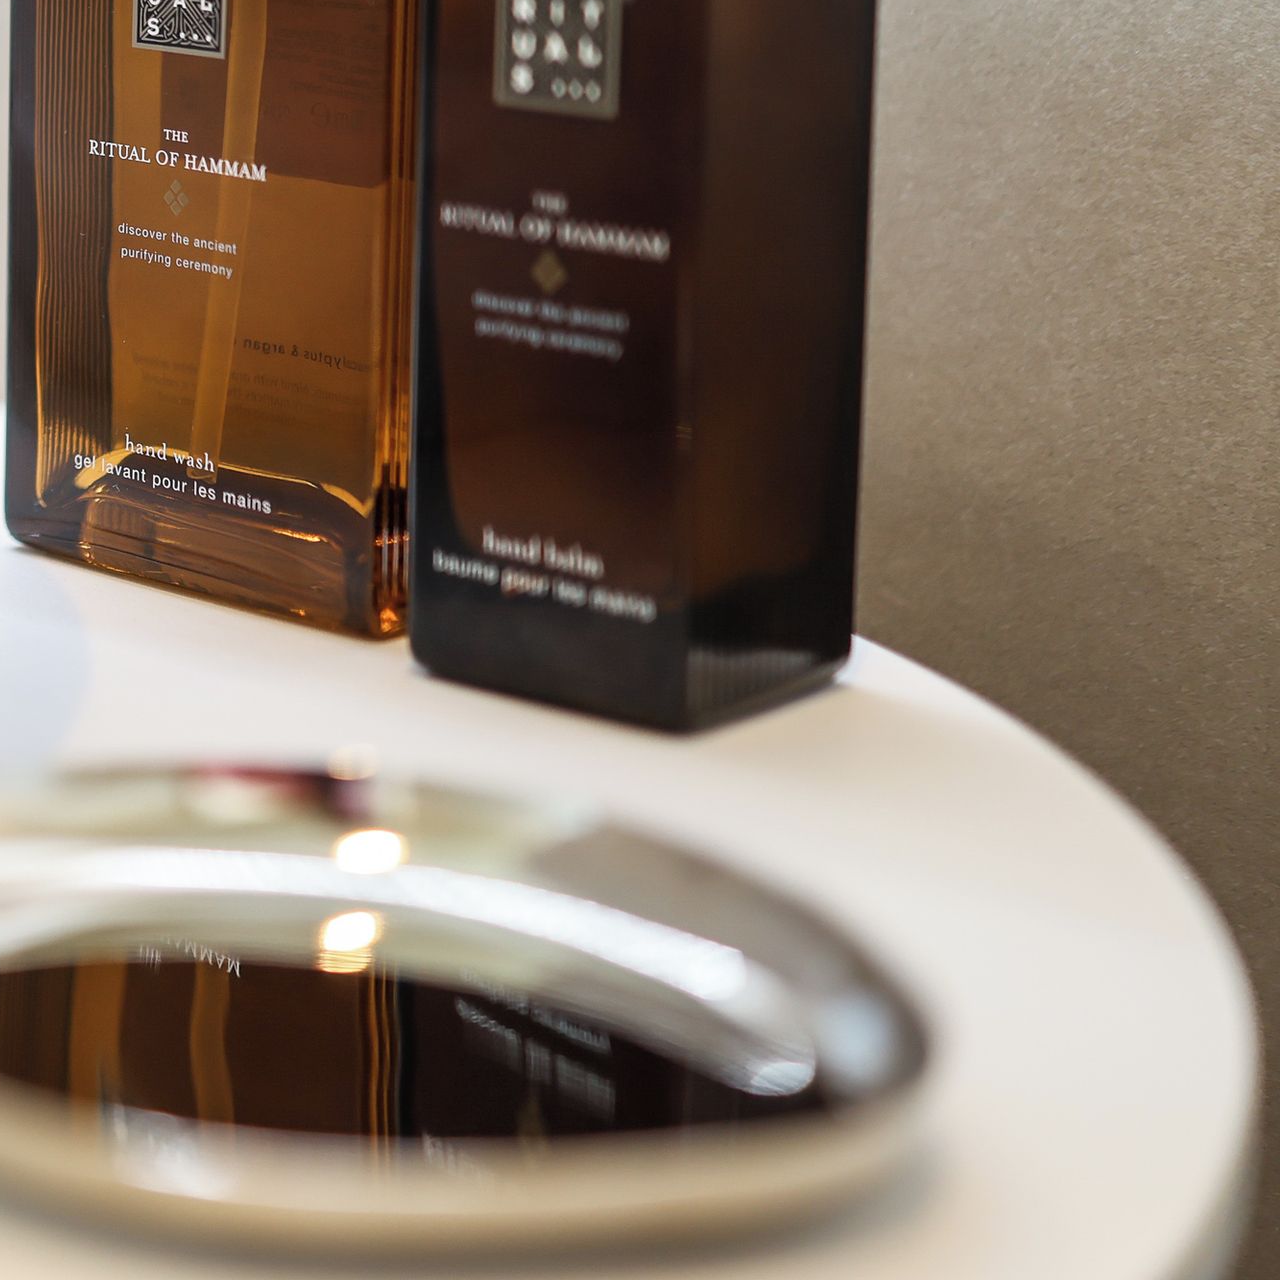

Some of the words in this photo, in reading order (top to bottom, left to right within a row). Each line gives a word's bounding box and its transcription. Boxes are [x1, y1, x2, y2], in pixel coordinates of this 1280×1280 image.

[163, 128, 189, 144] THE
[89, 139, 151, 164] RITUAL
[155, 149, 180, 168] OF
[183, 153, 267, 182] HAMMAM
[117, 222, 167, 241] discover
[171, 231, 190, 246] the
[193, 237, 237, 255] ancient
[121, 247, 172, 268] purifying
[175, 257, 233, 280] ceremony
[125, 433, 168, 462] hand
[173, 450, 215, 473] wash
[74, 453, 96, 470] gel
[101, 458, 146, 483] lavant
[152, 474, 187, 493] pour
[193, 481, 217, 501] les
[222, 491, 272, 515] mains
